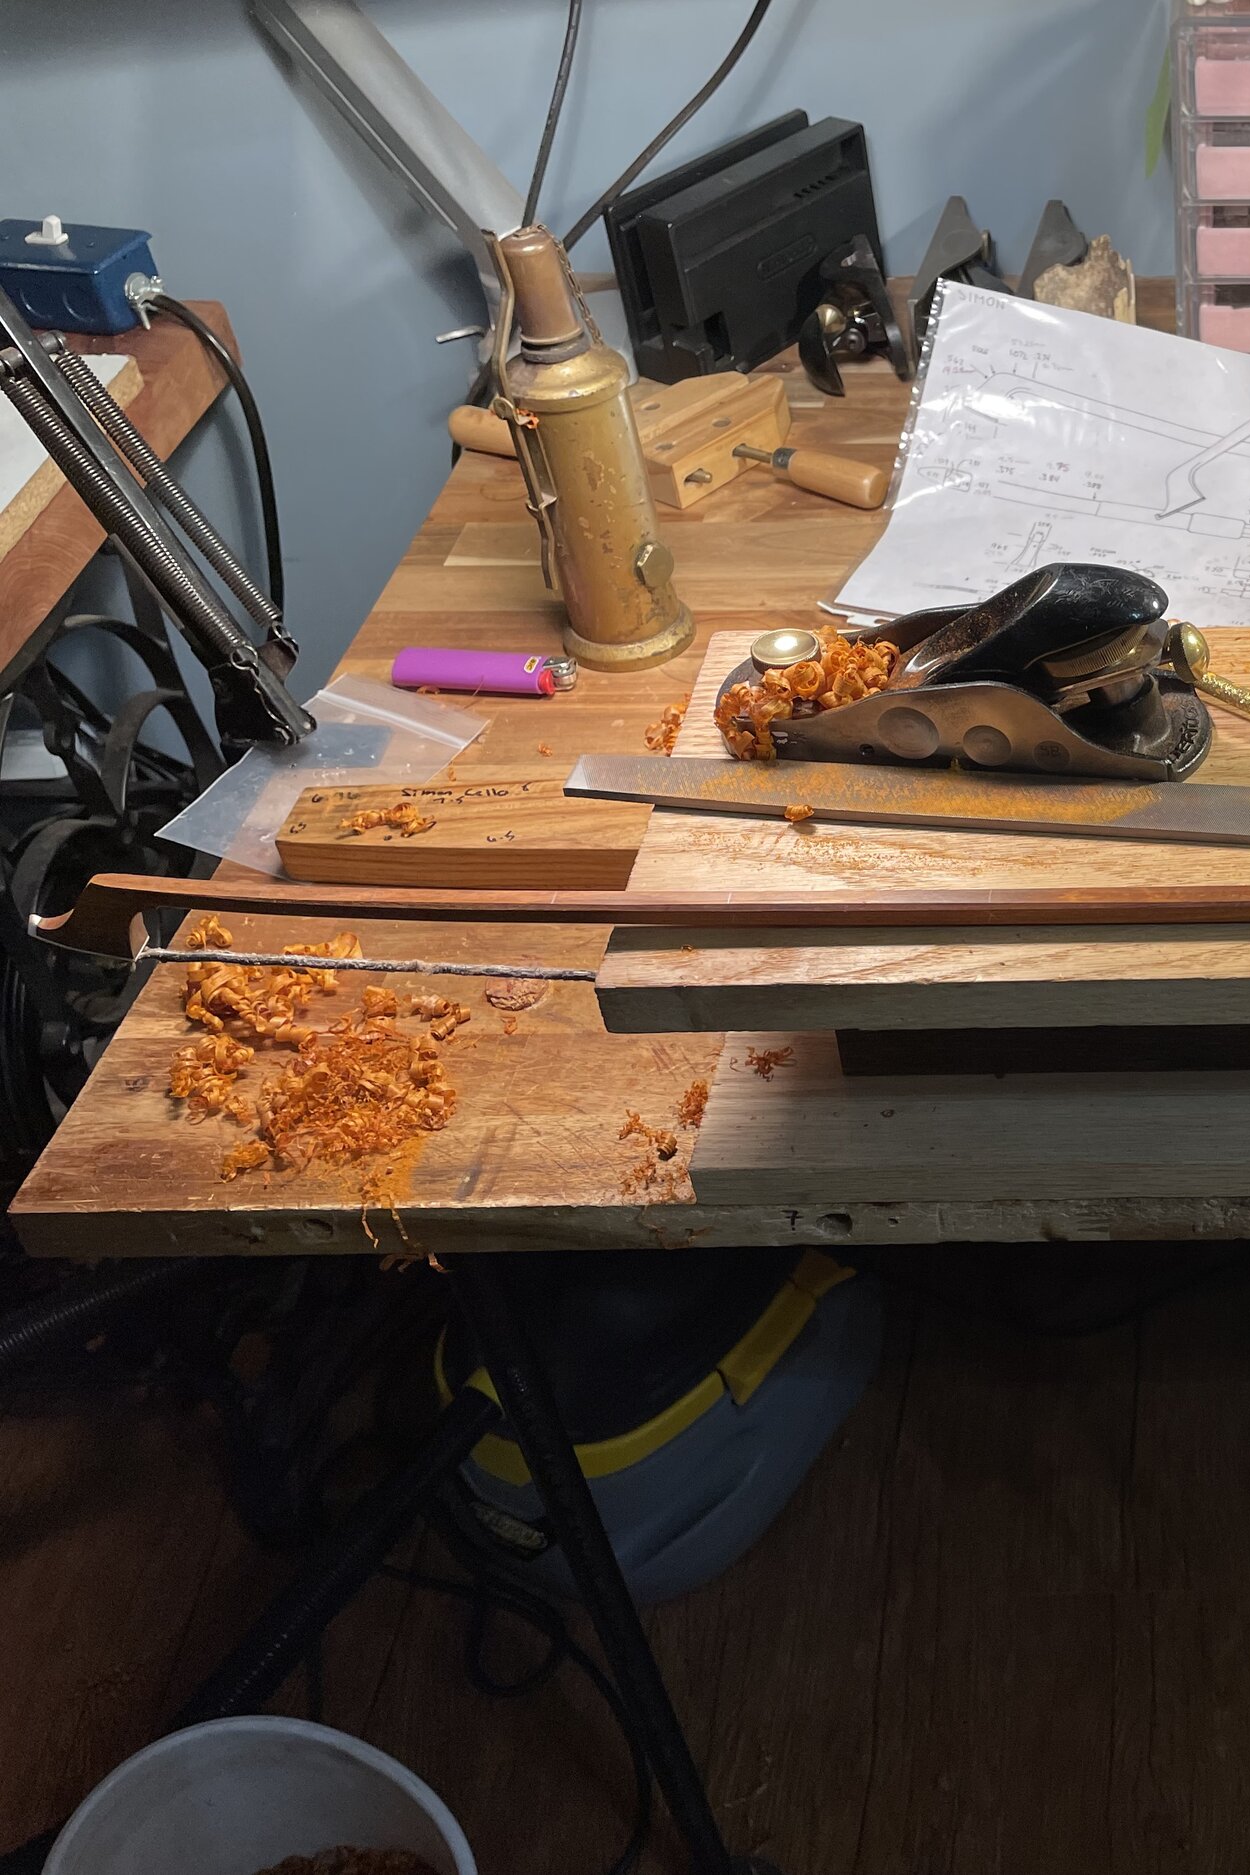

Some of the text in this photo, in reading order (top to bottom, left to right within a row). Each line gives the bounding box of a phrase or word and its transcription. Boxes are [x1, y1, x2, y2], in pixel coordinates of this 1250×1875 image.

[957, 289, 1007, 310] SIMON
[401, 788, 510, 797] Simon Cello
